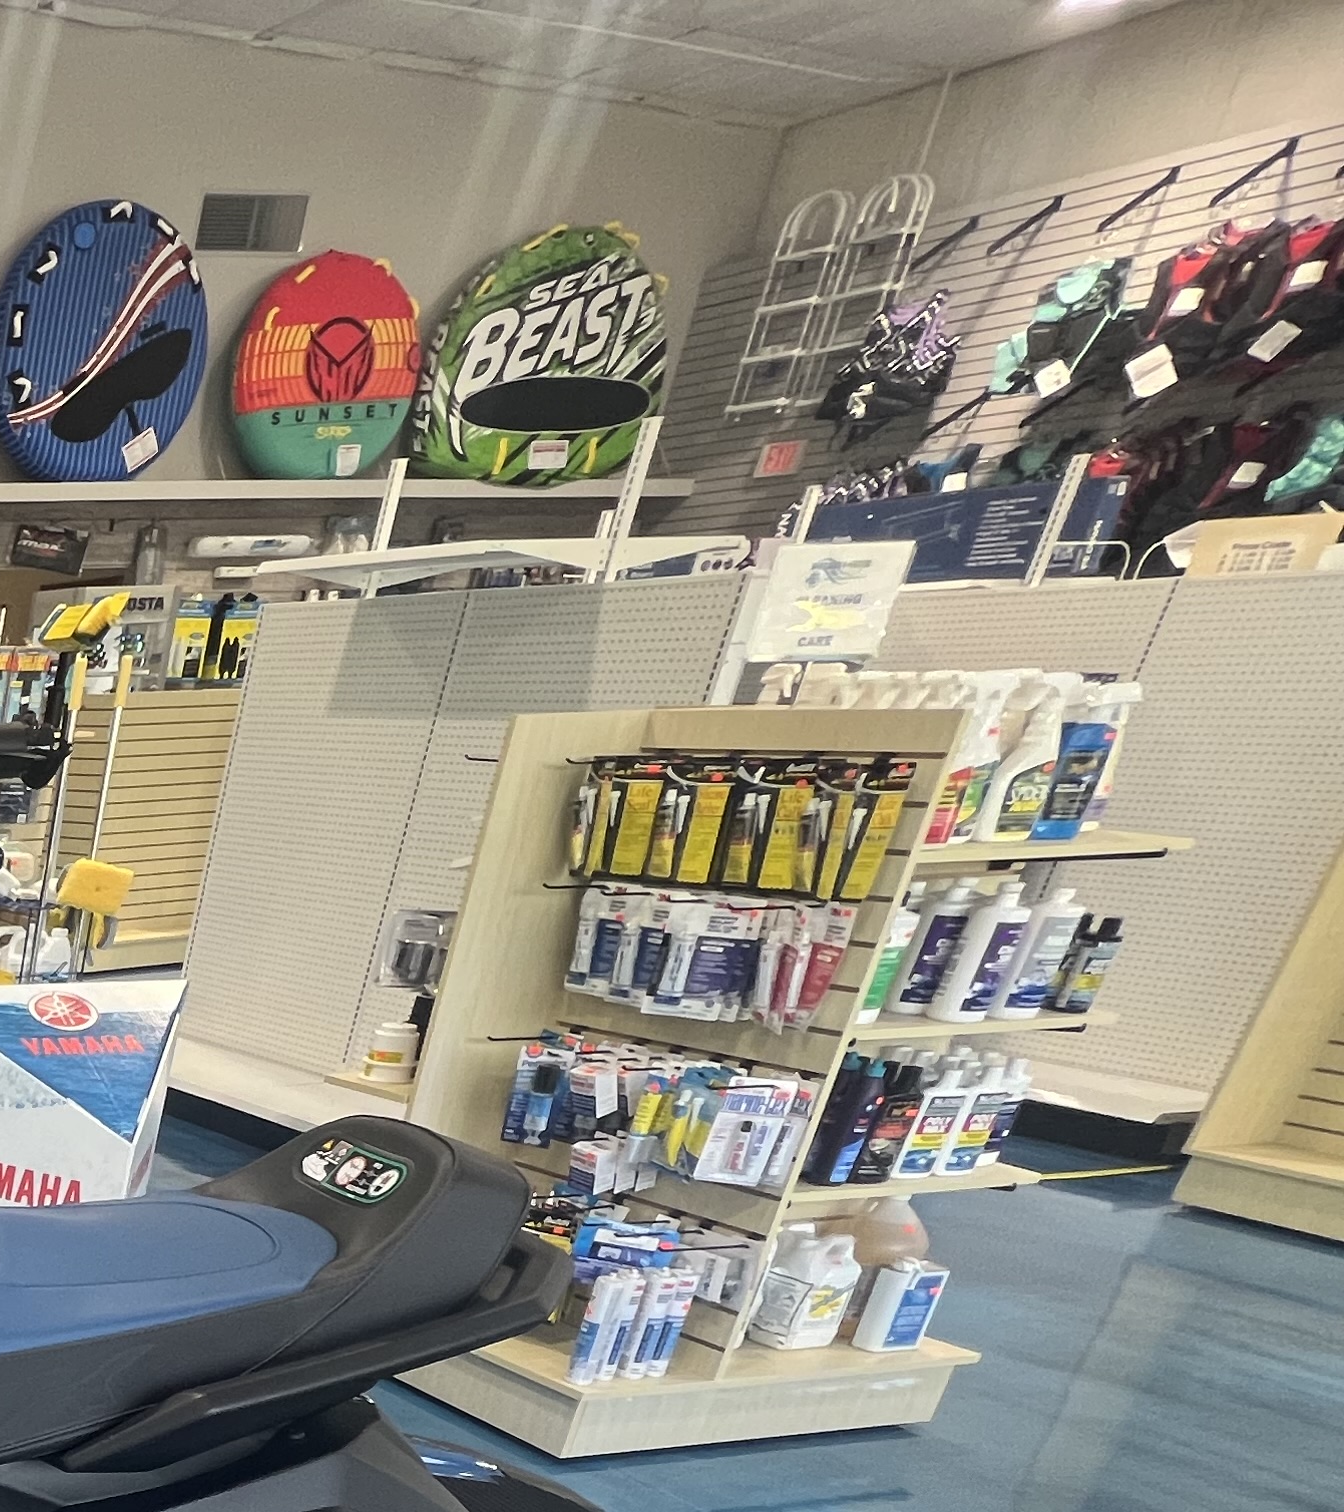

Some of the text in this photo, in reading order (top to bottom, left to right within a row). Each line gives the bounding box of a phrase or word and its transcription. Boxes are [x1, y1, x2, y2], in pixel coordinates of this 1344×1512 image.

[524, 254, 616, 310] SEA
[453, 275, 652, 404] BEAST
[271, 403, 397, 425] SUNSET
[126, 597, 164, 610] OSTA
[20, 1034, 145, 1056] YAMAHA
